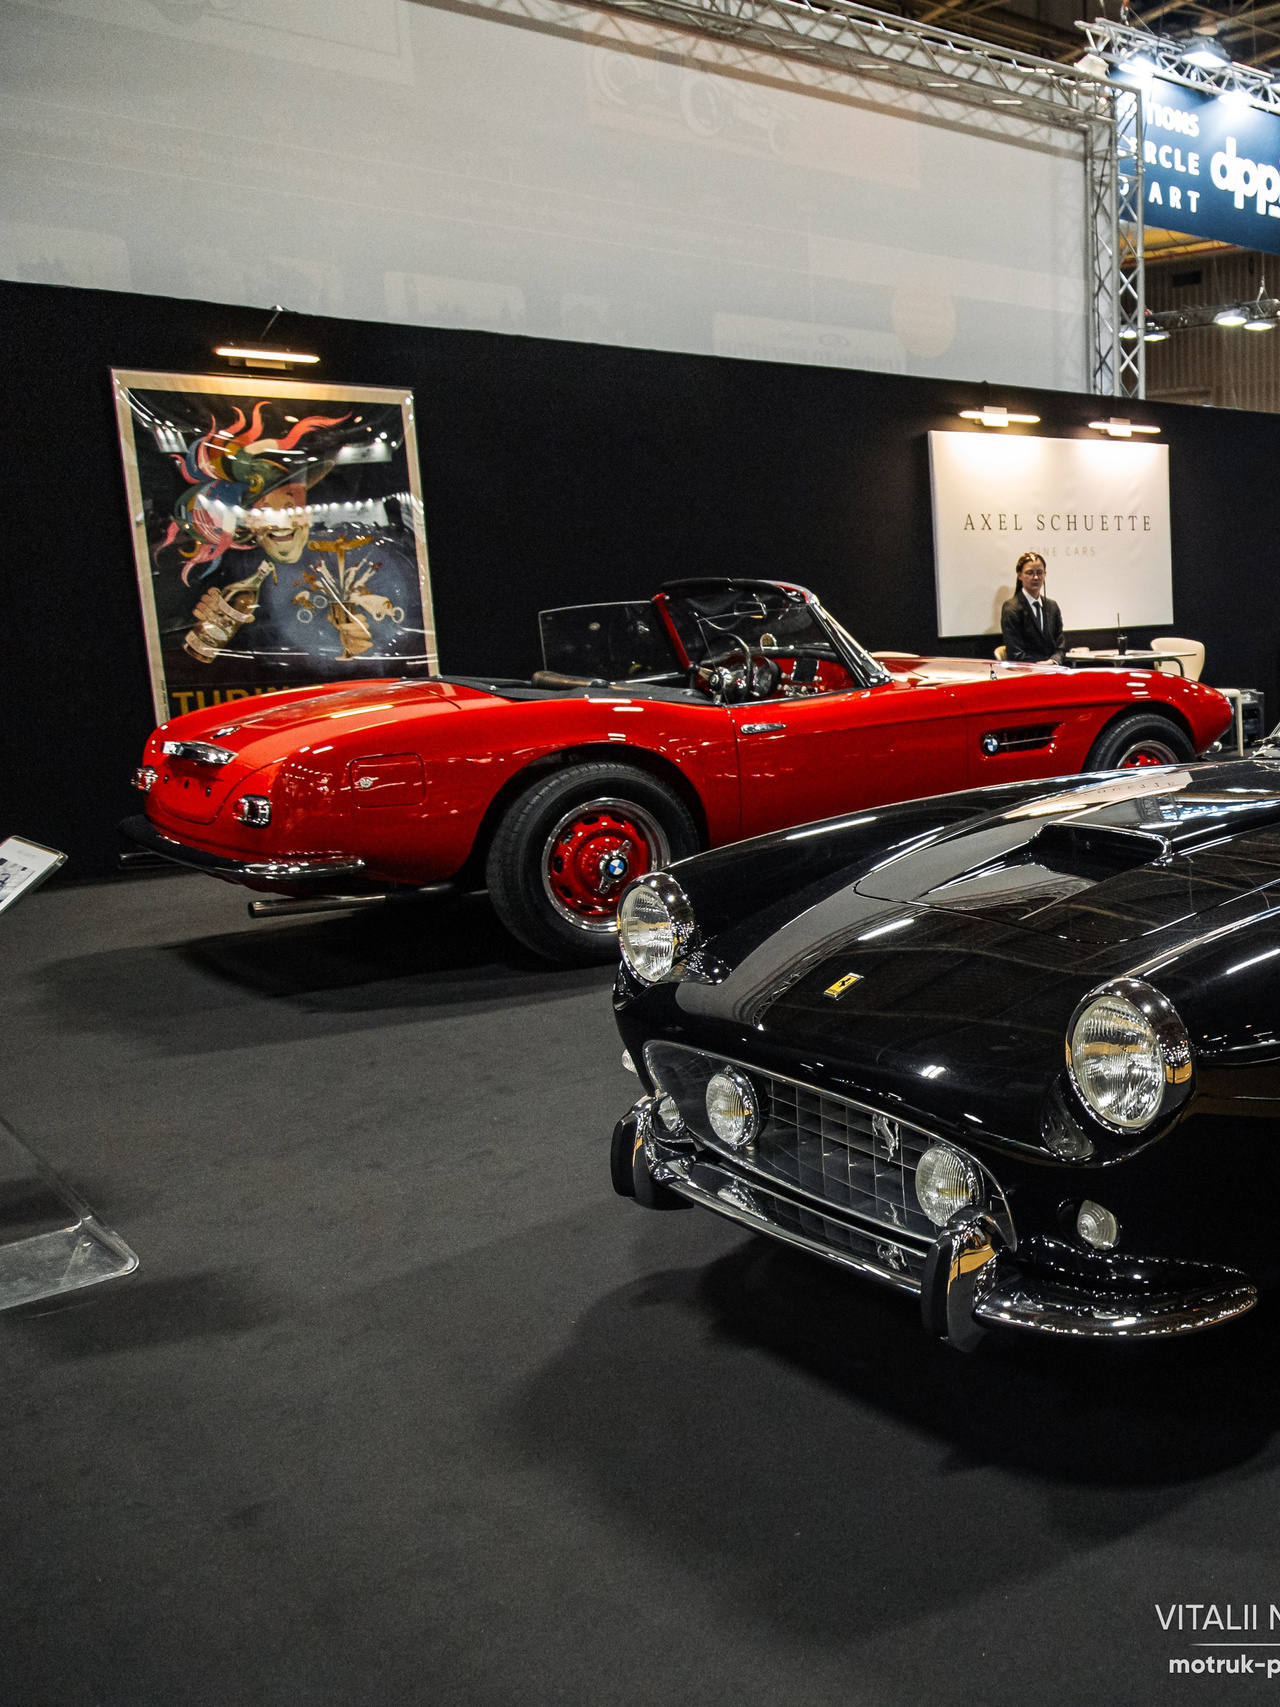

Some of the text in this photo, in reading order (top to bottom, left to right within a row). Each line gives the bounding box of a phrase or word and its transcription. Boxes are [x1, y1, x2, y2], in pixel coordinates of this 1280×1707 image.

[964, 513, 1151, 532] AXEL SCHUETTE
[1065, 546, 1096, 557] CARS
